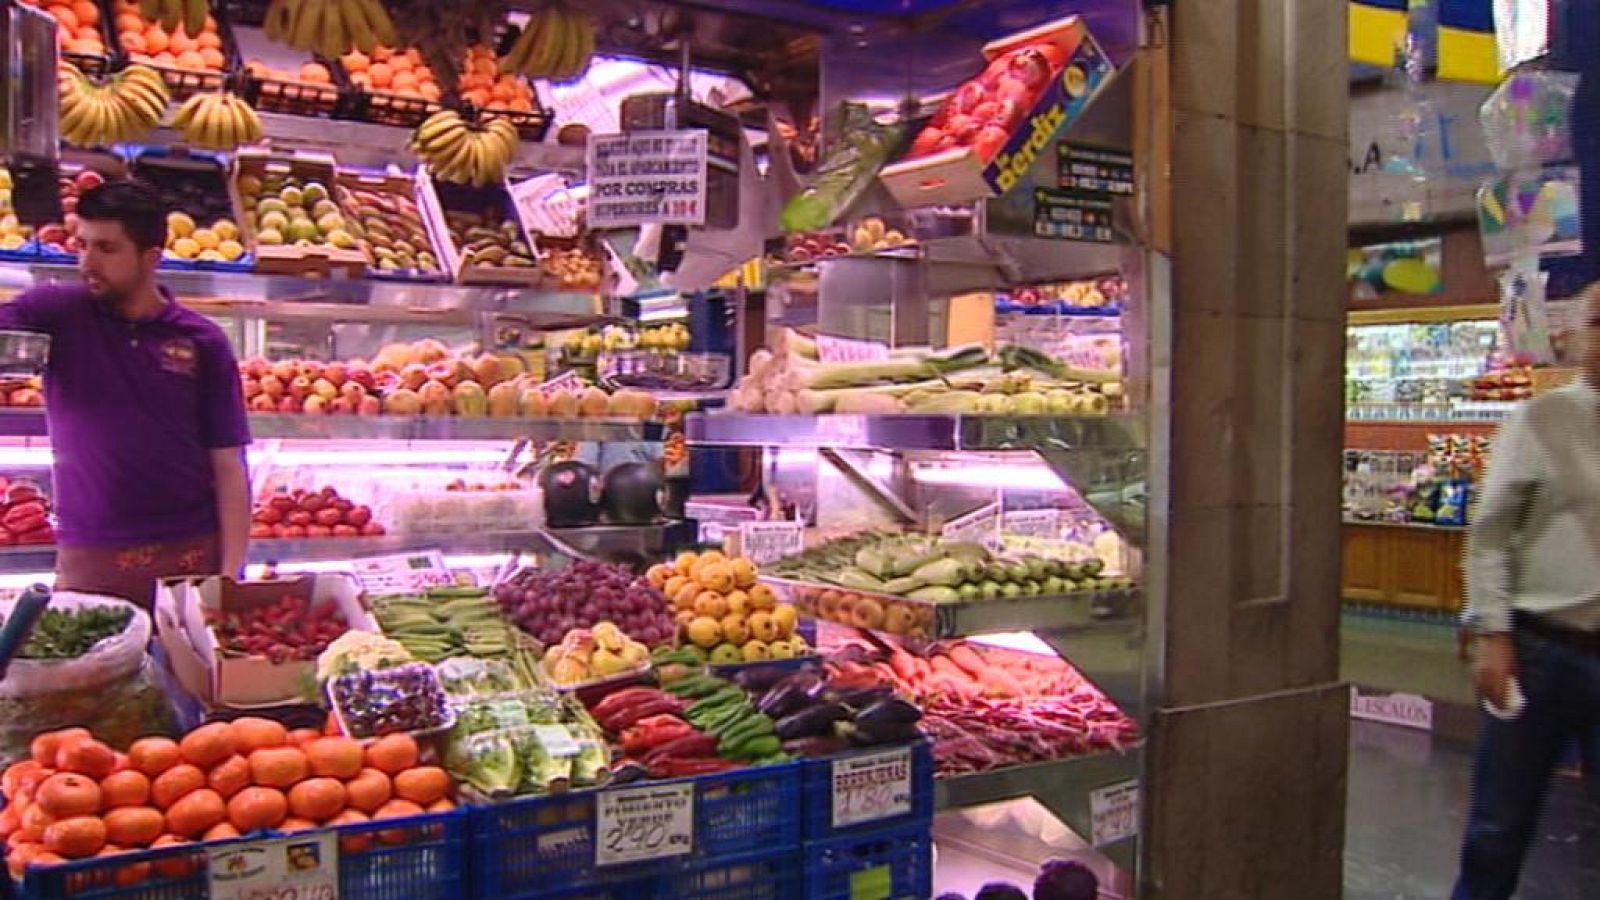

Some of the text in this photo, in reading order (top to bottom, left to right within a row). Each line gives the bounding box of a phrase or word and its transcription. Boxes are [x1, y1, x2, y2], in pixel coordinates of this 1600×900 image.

[595, 180, 699, 197] POR COMPRAS
[605, 799, 686, 817] PIMIENTO
